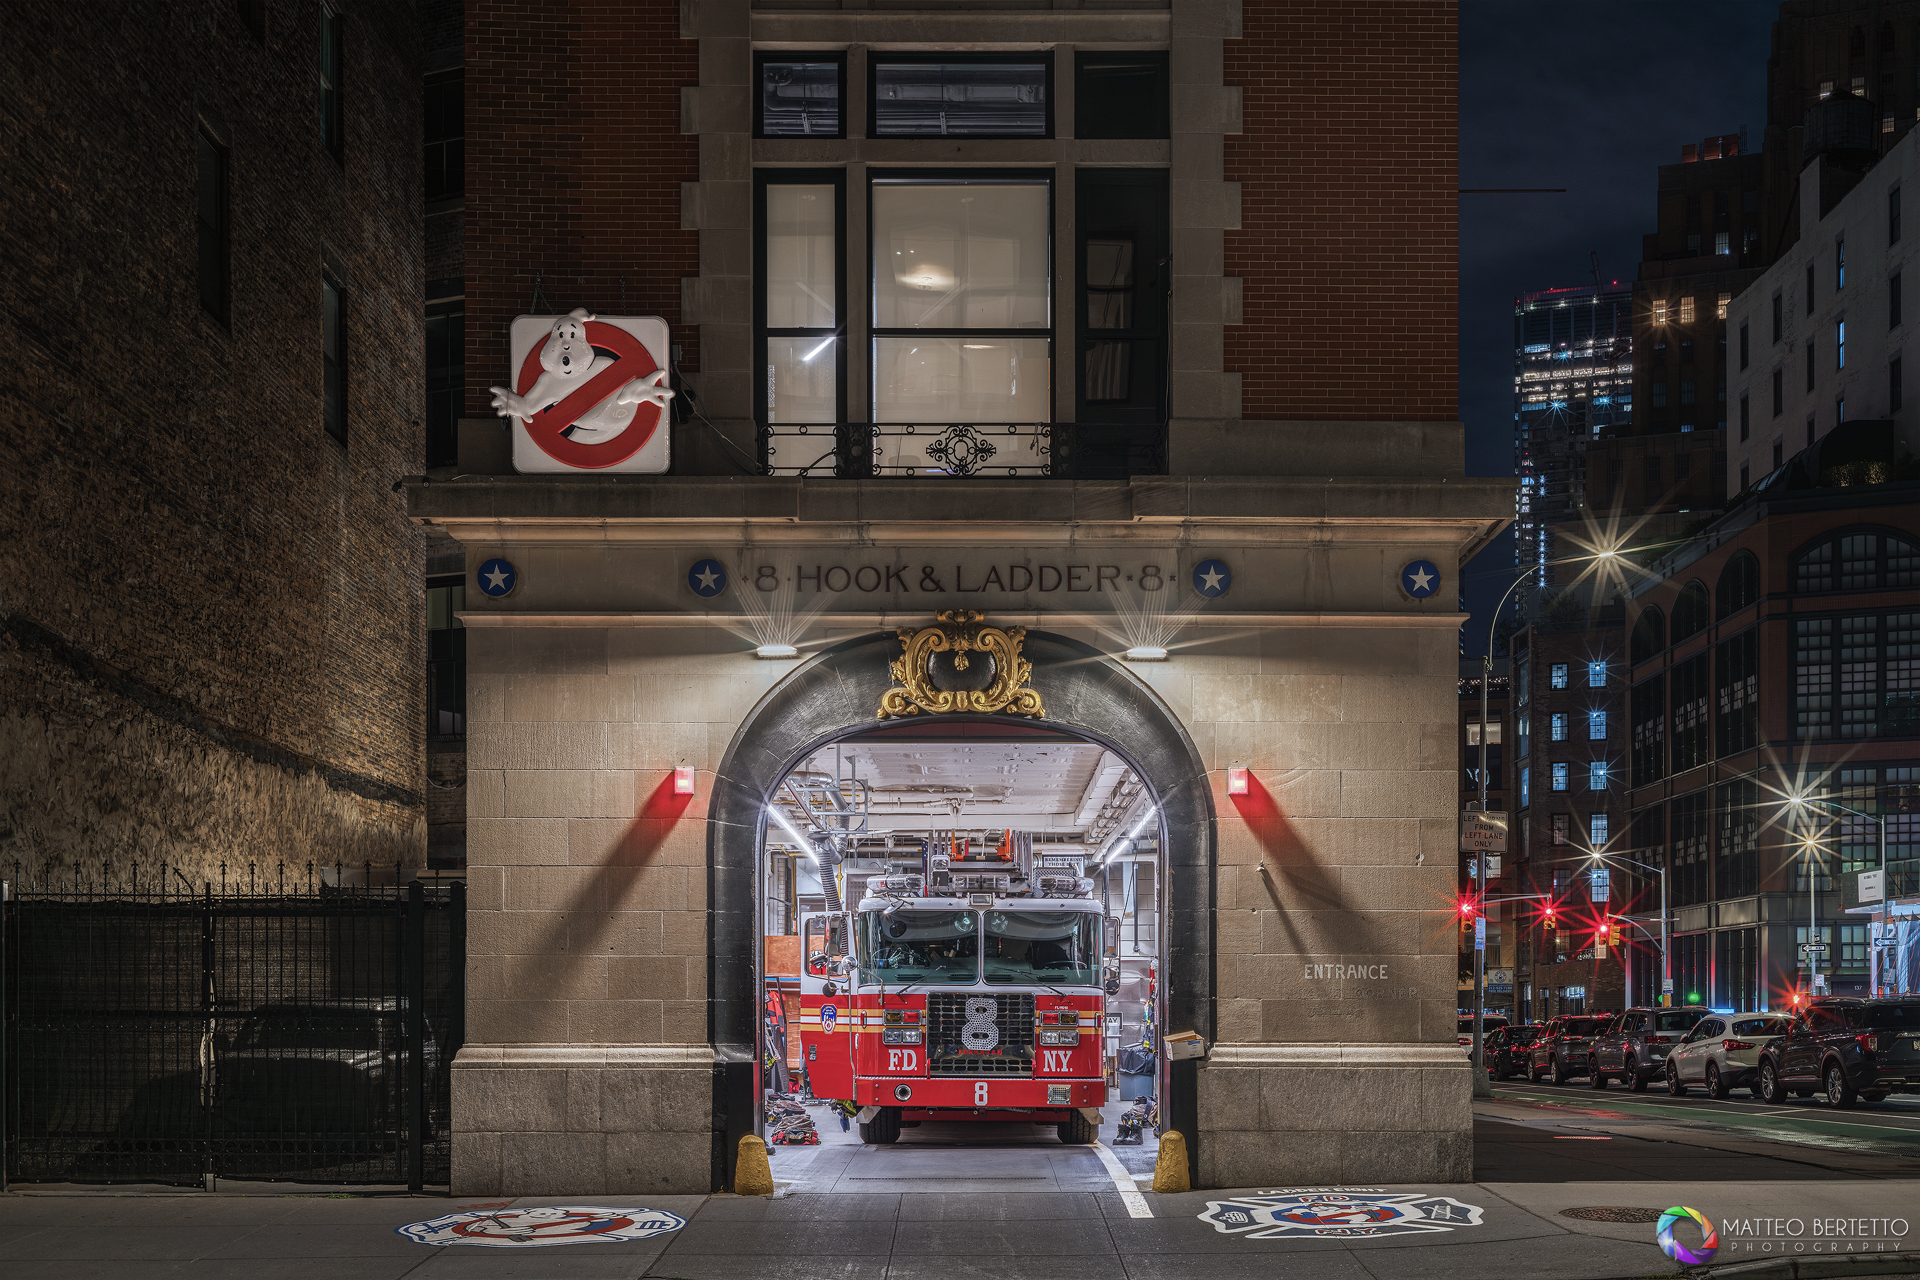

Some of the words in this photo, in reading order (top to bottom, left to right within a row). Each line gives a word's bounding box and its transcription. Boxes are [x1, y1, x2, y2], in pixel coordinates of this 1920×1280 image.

[755, 565, 779, 592] 8
[797, 565, 910, 592] HOOK
[919, 565, 946, 592] &
[956, 565, 1121, 592] LADDER
[1138, 565, 1164, 592] 8
[1304, 964, 1388, 980] ENTRANCE
[962, 997, 999, 1050] 8
[888, 1049, 918, 1071] F.D.
[1043, 1050, 1073, 1072] N.Y.
[974, 1081, 988, 1106] 8
